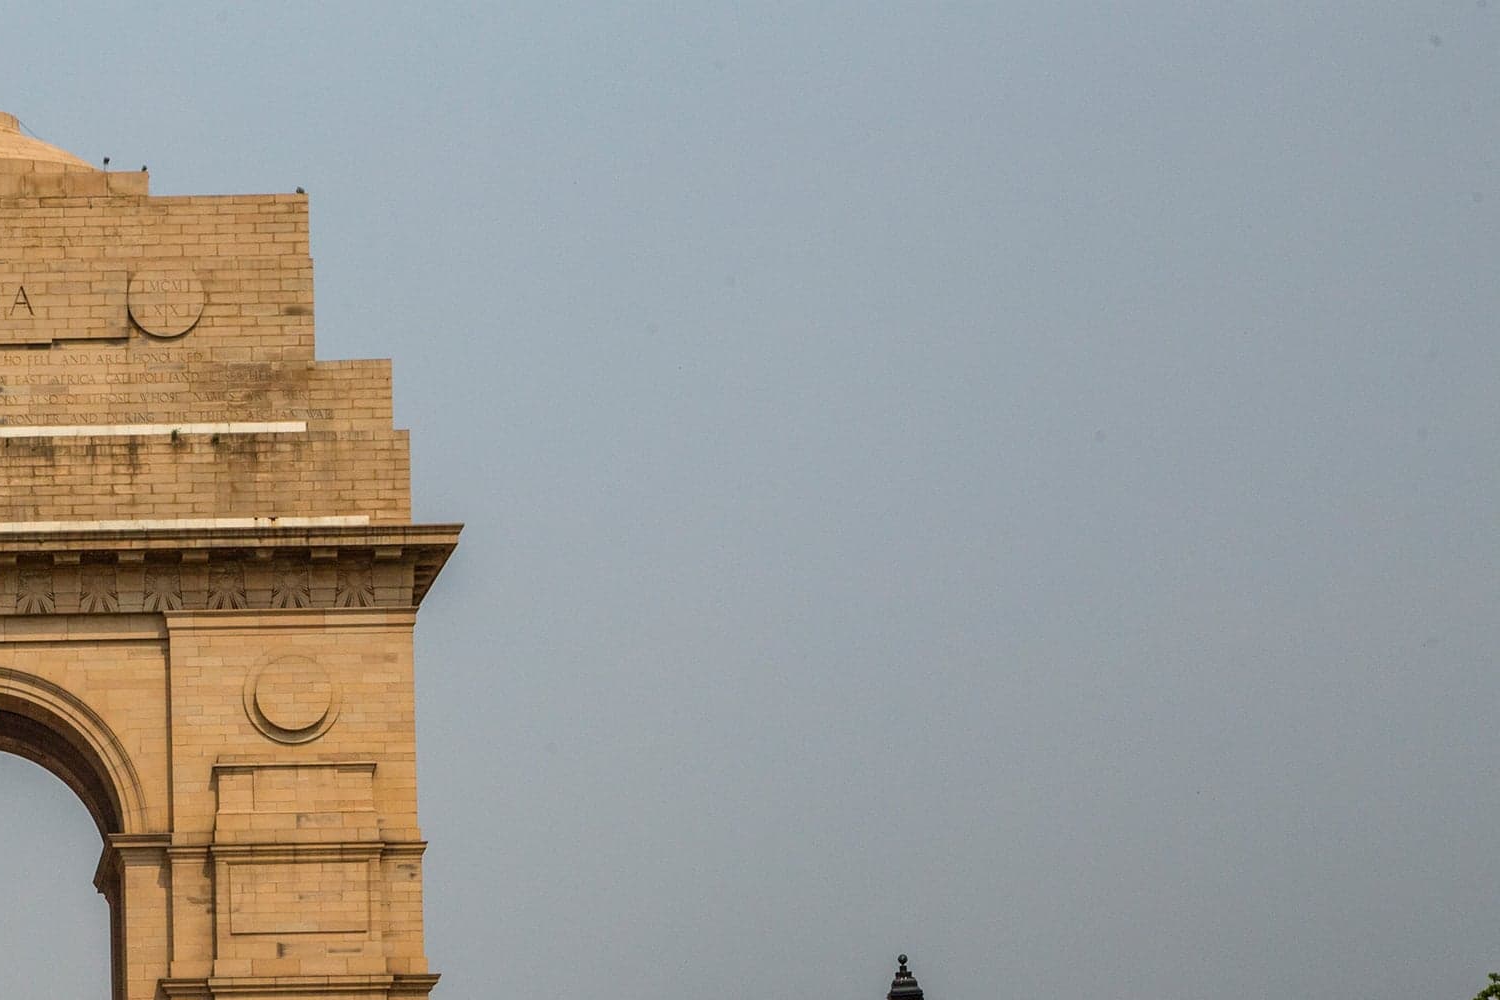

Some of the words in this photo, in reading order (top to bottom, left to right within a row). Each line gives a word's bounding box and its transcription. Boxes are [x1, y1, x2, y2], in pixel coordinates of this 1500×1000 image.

[28, 354, 50, 365] FELL
[62, 354, 88, 364] AND
[97, 353, 120, 364] ARE
[133, 352, 203, 363] HONOURED
[50, 373, 96, 384] AFRICA
[69, 412, 98, 422] AND
